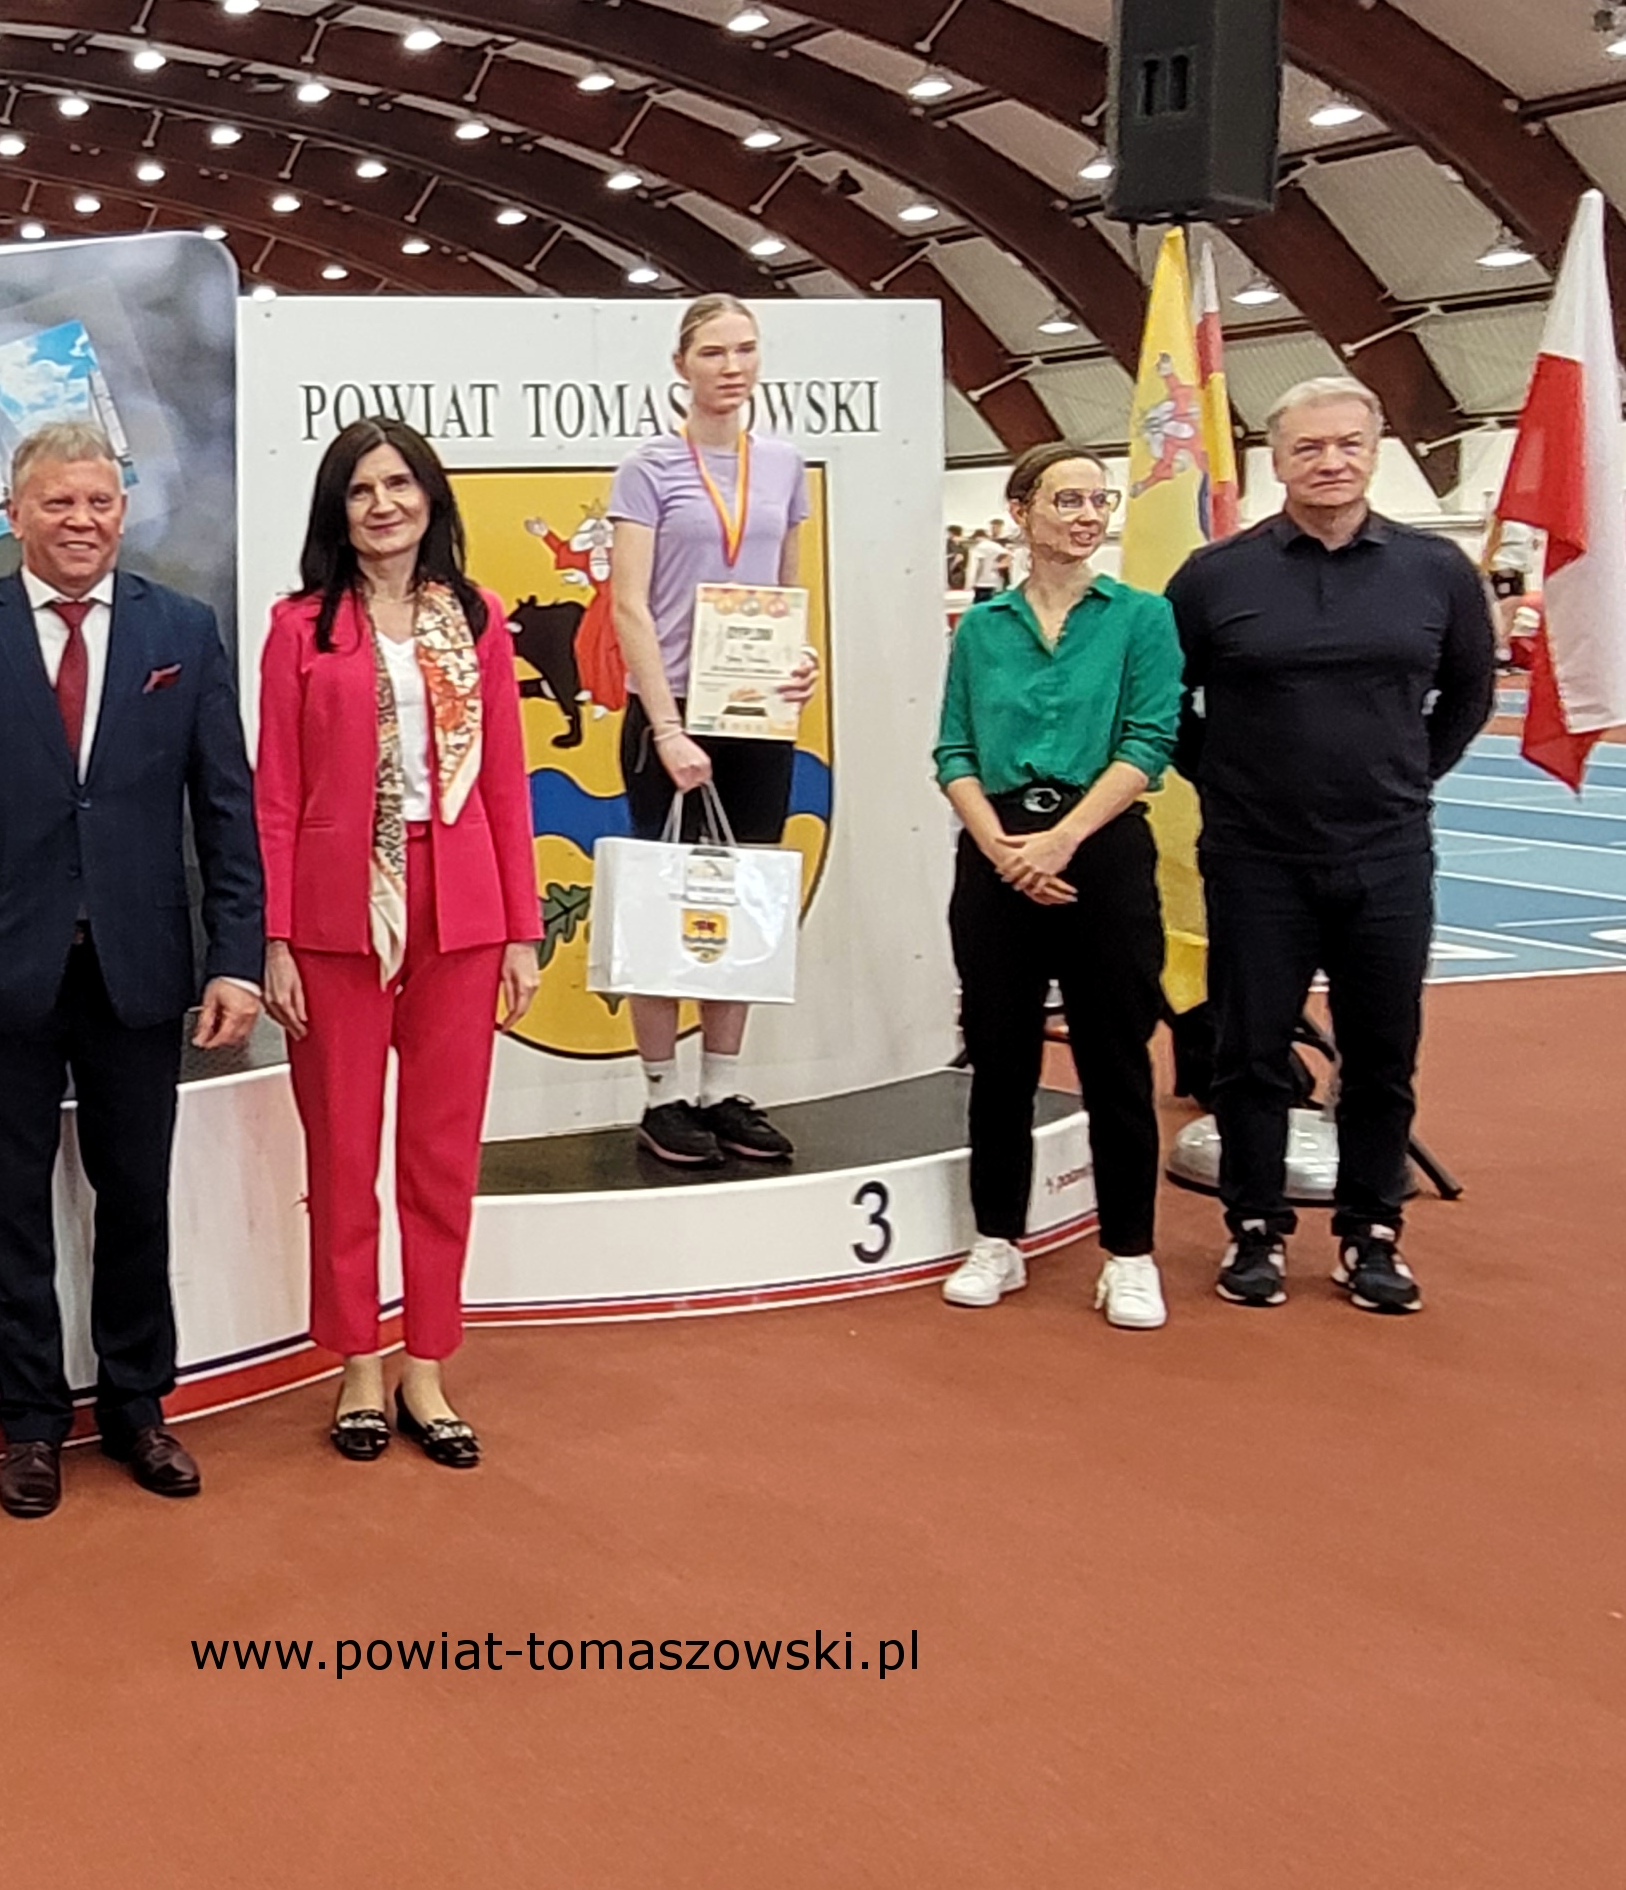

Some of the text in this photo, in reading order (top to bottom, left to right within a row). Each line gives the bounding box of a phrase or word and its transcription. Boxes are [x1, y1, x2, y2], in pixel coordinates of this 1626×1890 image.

[299, 380, 882, 441] POWIAT TOMASWSKI
[851, 1180, 892, 1265] 3
